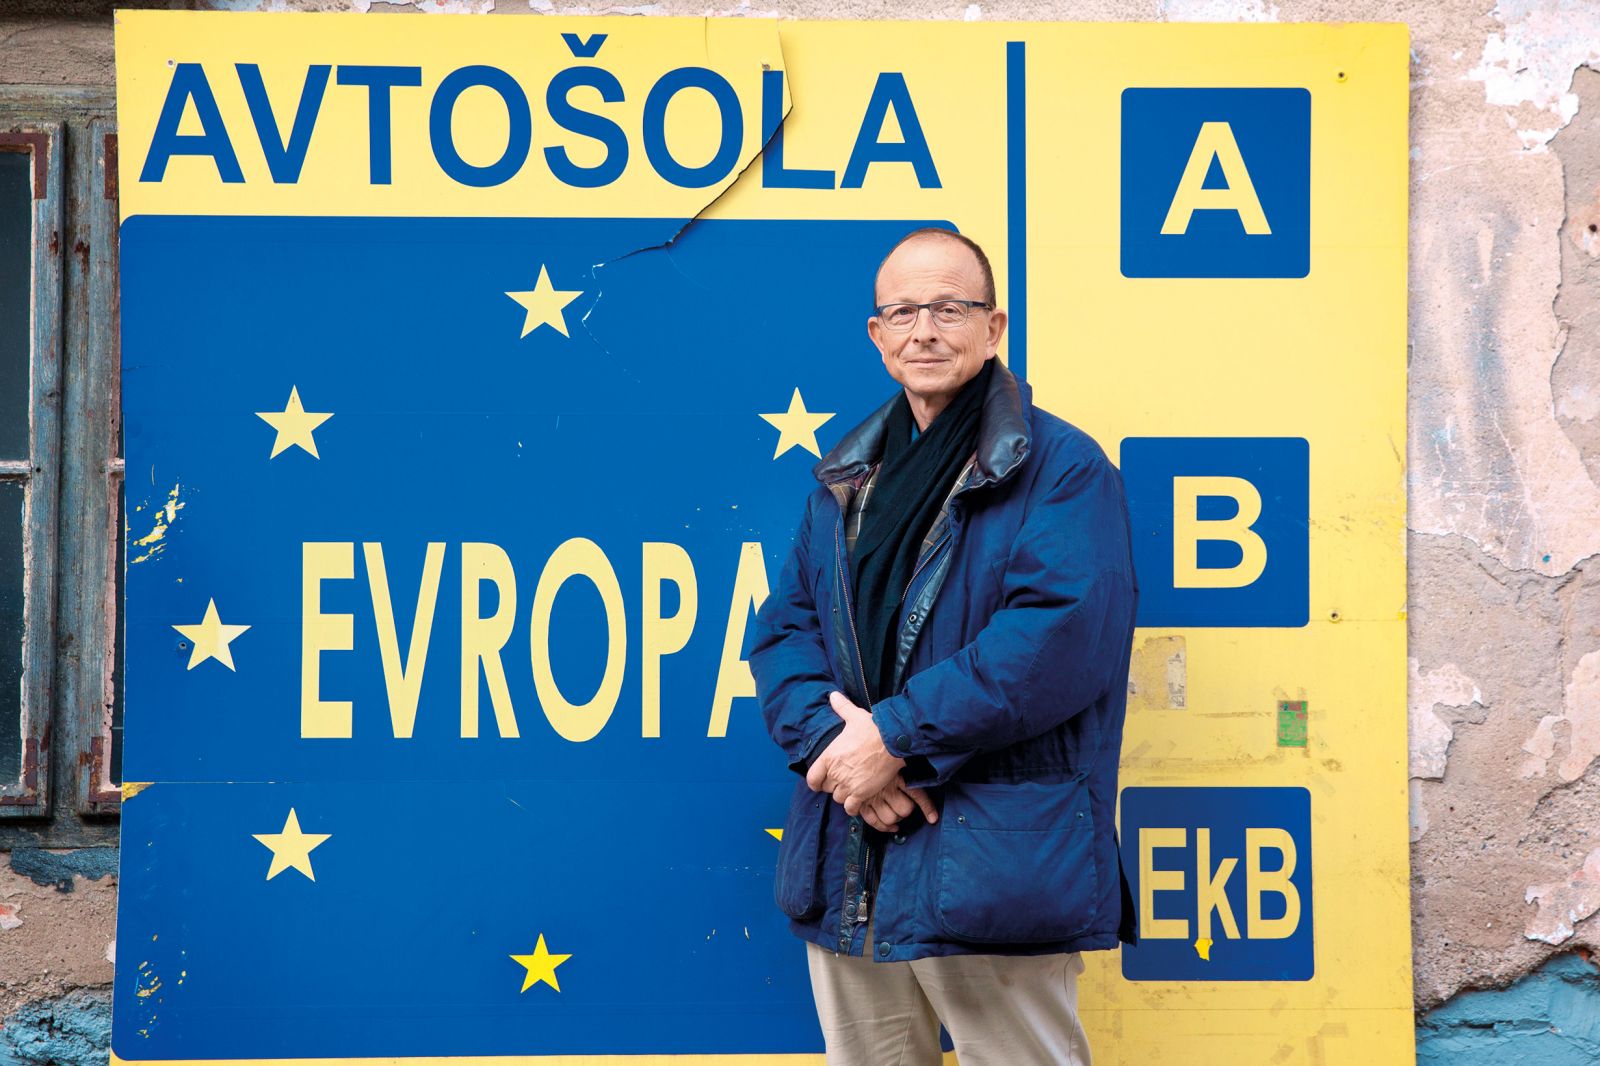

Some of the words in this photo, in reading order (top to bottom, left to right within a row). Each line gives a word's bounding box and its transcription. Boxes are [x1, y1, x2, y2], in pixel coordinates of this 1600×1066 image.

[139, 34, 942, 188] AVTOŠOLA
[1161, 122, 1271, 234] A
[1174, 477, 1267, 588] B
[301, 538, 770, 742] EVROPA
[1139, 828, 1301, 939] EkB
